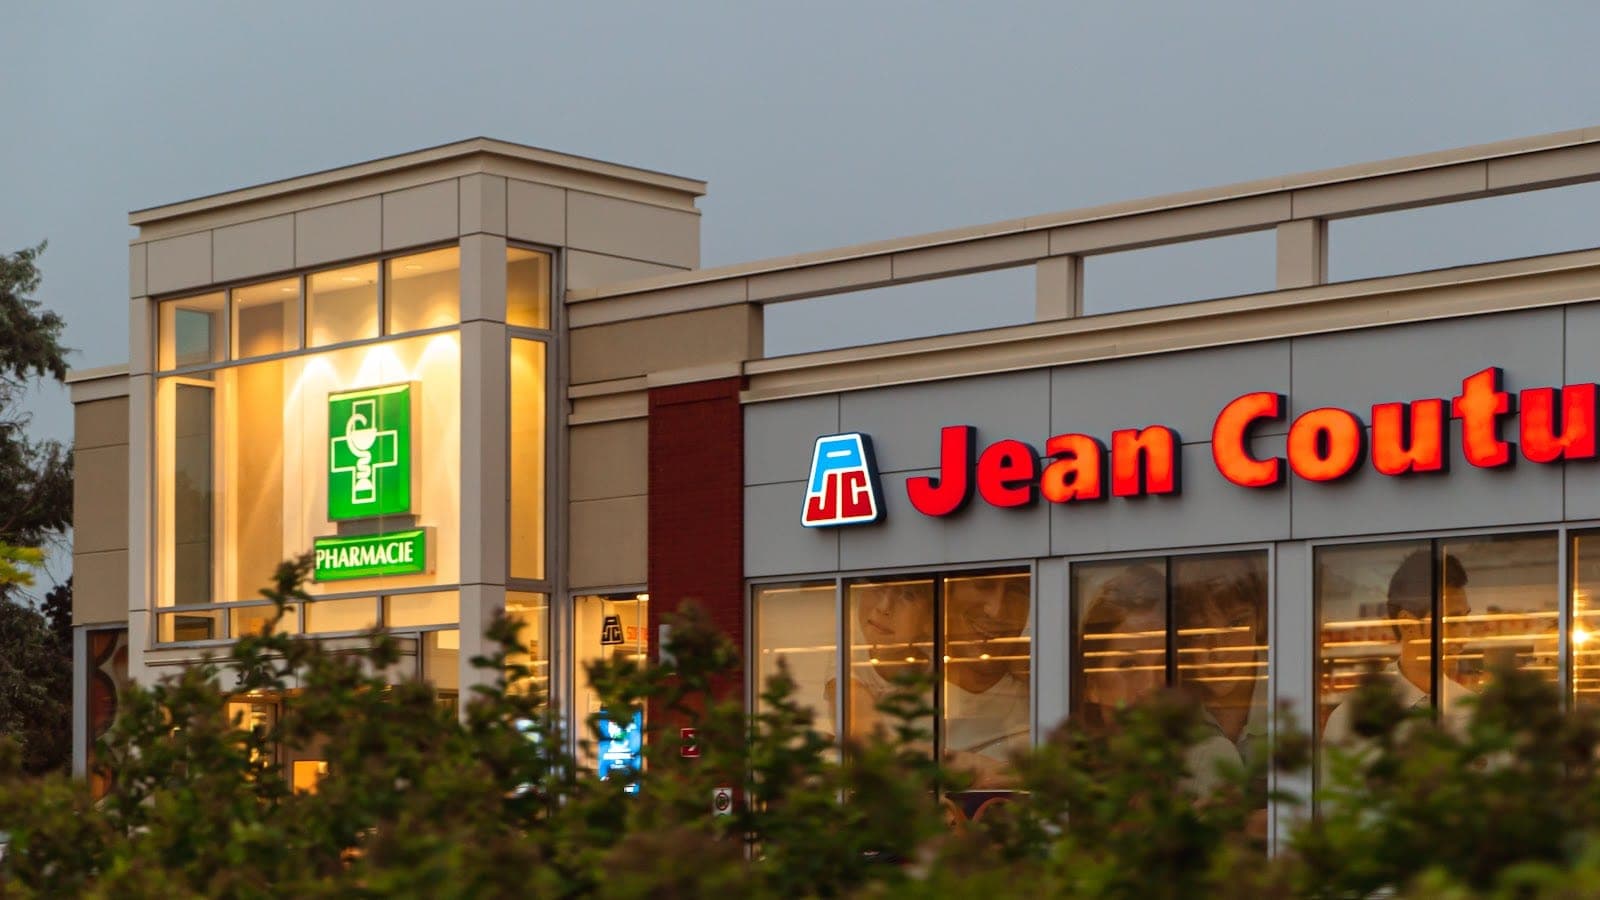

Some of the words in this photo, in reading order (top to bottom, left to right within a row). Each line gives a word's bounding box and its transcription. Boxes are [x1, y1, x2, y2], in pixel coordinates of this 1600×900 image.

[905, 425, 1177, 518] Jean
[1211, 366, 1599, 488] Coutu
[315, 541, 414, 570] PHARMACIE
